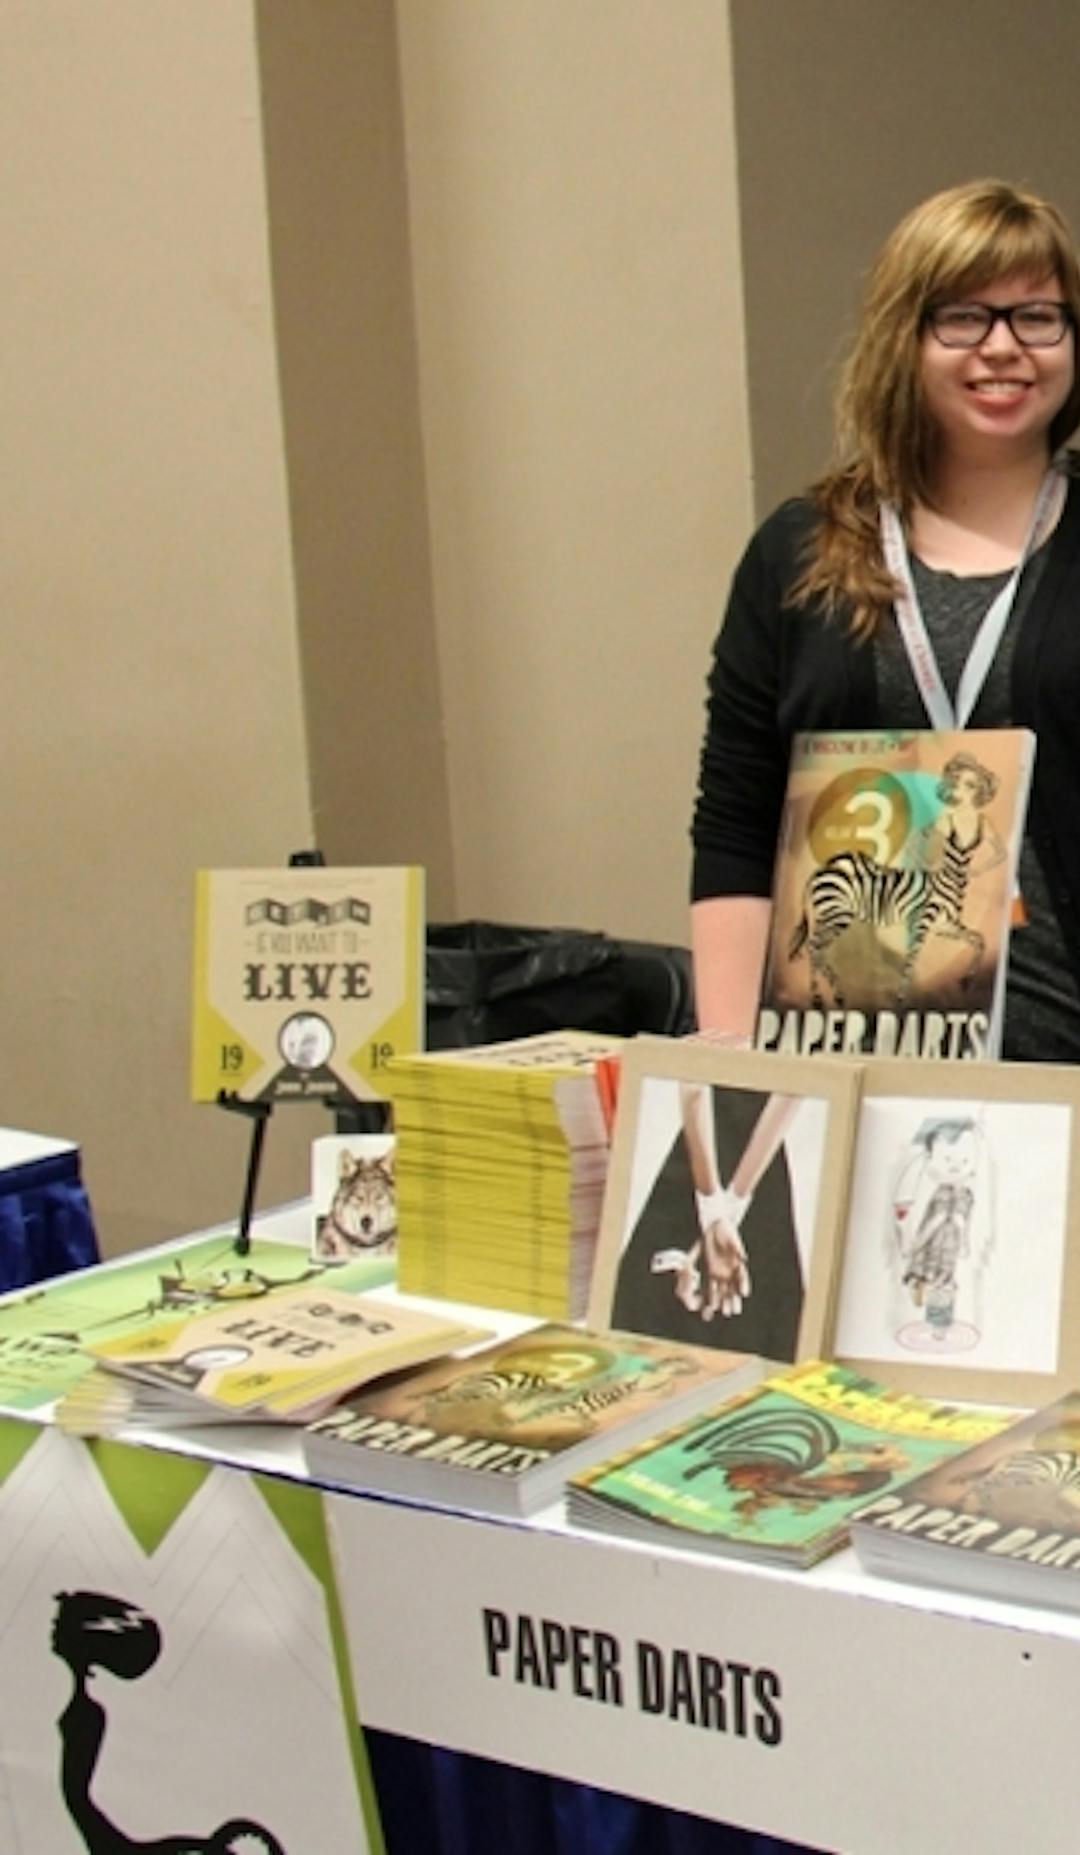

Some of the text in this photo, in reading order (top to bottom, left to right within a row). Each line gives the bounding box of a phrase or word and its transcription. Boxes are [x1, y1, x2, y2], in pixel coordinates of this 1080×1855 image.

[243, 962, 371, 1001] LIVE
[757, 1008, 989, 1060] PAPER DARTS
[220, 1045, 243, 1071] 19
[221, 1318, 337, 1358] LIVE
[302, 1408, 437, 1453] PAPER
[851, 1496, 1000, 1548] PAPER
[482, 1607, 783, 1748] PAPER DARTS
